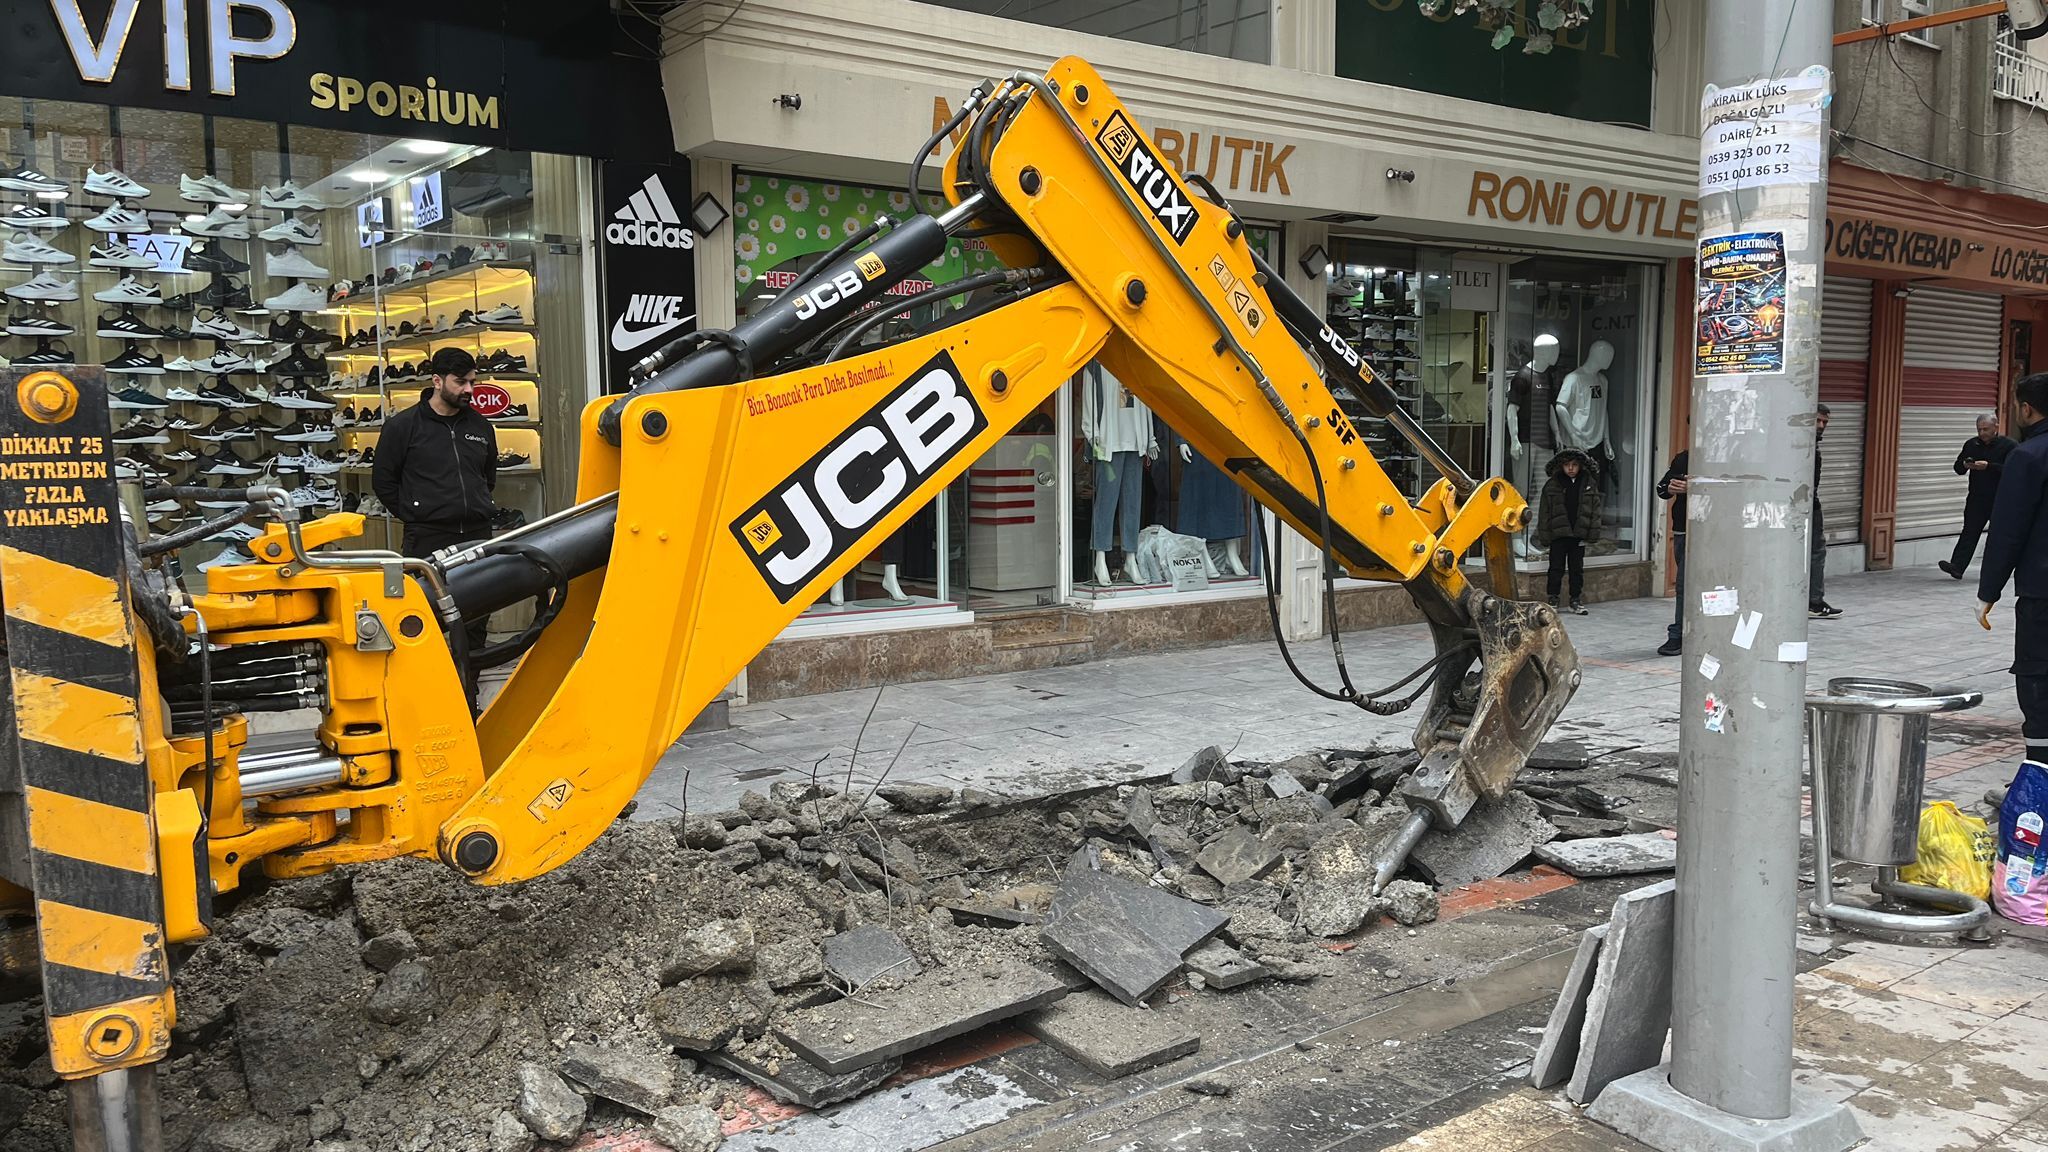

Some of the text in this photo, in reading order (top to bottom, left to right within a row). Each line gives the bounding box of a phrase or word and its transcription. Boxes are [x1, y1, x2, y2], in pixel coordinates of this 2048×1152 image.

[47, 0, 297, 96] VIP
[1756, 85, 1787, 99] LÜKS
[1109, 129, 1130, 157] JCB
[1720, 125, 1777, 143] DAİRE 2+1
[1708, 143, 1790, 165] 0539 323 00 72
[1707, 163, 1789, 184] 0551 001 86 53
[417, 206, 439, 225] adidas
[1576, 186, 1699, 241] OUTLE
[606, 220, 694, 249] adidas
[1898, 230, 1962, 270] KEBAP
[862, 260, 883, 275] JCB
[1990, 246, 2012, 279] LO
[795, 270, 863, 321] JCB
[625, 294, 683, 323] NIKE
[1319, 327, 1359, 368] JCB
[470, 394, 503, 409] AÇIK
[765, 385, 803, 411] Bozacak
[802, 383, 825, 401] Para
[0, 433, 103, 455] DİKKAT 25
[0, 461, 107, 480] METREDEN
[765, 368, 975, 585] JCB
[24, 485, 86, 504] FAZLA
[3, 507, 109, 528] YAKLAŞMA
[752, 523, 772, 541] JCB
[1173, 558, 1202, 567] NOKTA
